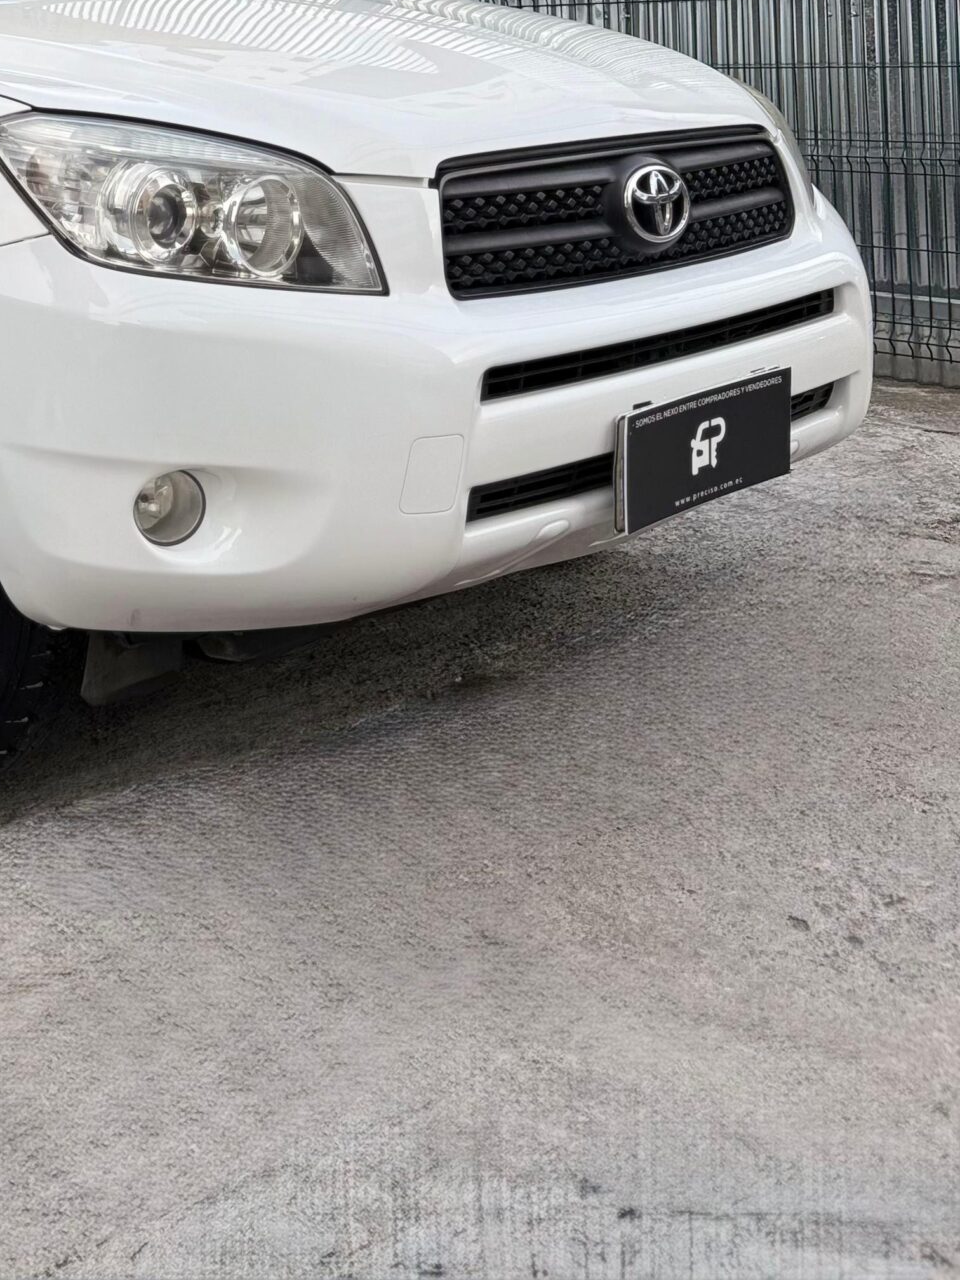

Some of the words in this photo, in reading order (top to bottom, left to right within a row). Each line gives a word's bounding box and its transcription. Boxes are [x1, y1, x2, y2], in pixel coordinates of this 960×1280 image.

[635, 414, 656, 429] SOMOS
[656, 412, 663, 421] EL
[663, 406, 679, 419] NEXO
[679, 400, 698, 413] ENTRE
[697, 387, 741, 407] COMPRADORES
[740, 385, 745, 394] Y
[745, 375, 783, 393] VENDEDORES
[674, 476, 744, 507] www.preciso.com.ec
